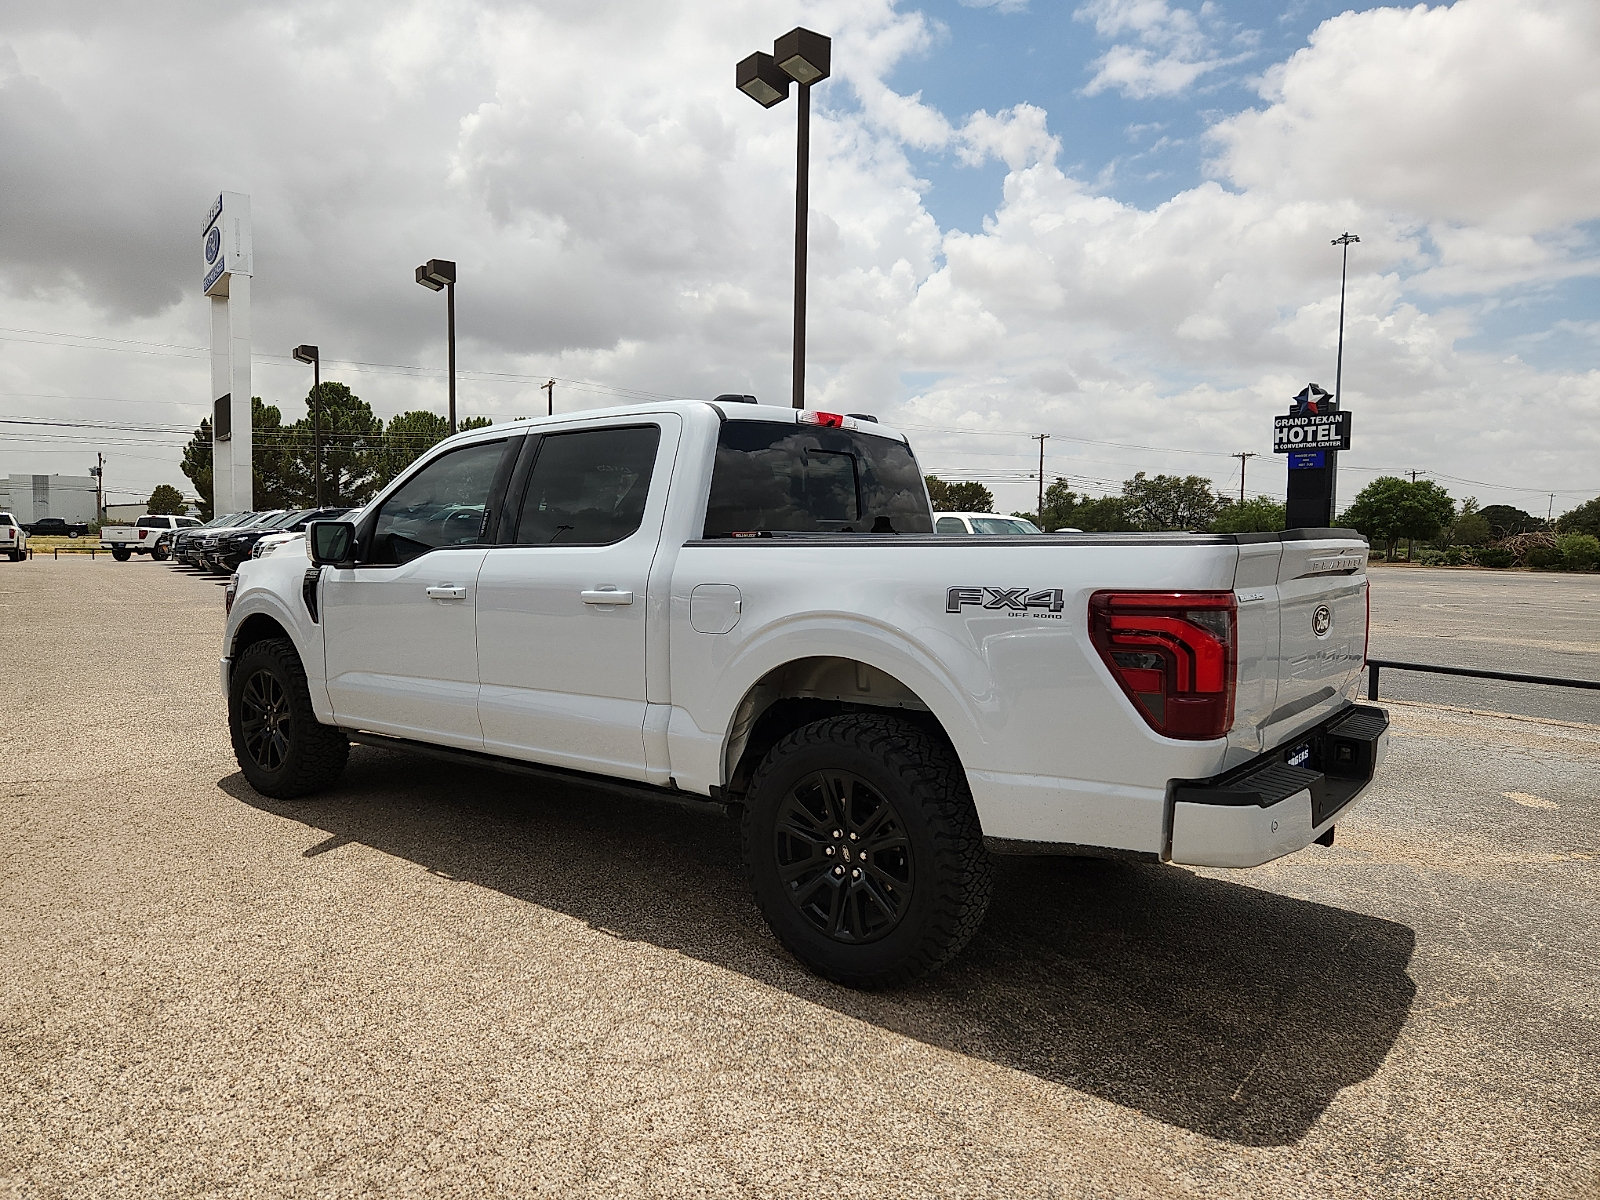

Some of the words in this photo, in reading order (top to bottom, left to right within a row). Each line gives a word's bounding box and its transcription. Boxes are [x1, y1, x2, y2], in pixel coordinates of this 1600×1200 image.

[1275, 417, 1308, 427] GRAND
[1310, 415, 1343, 424] TEXAN
[1274, 425, 1342, 443] HOTEL
[1280, 442, 1317, 450] CONVENTION
[945, 585, 1065, 614] FX4
